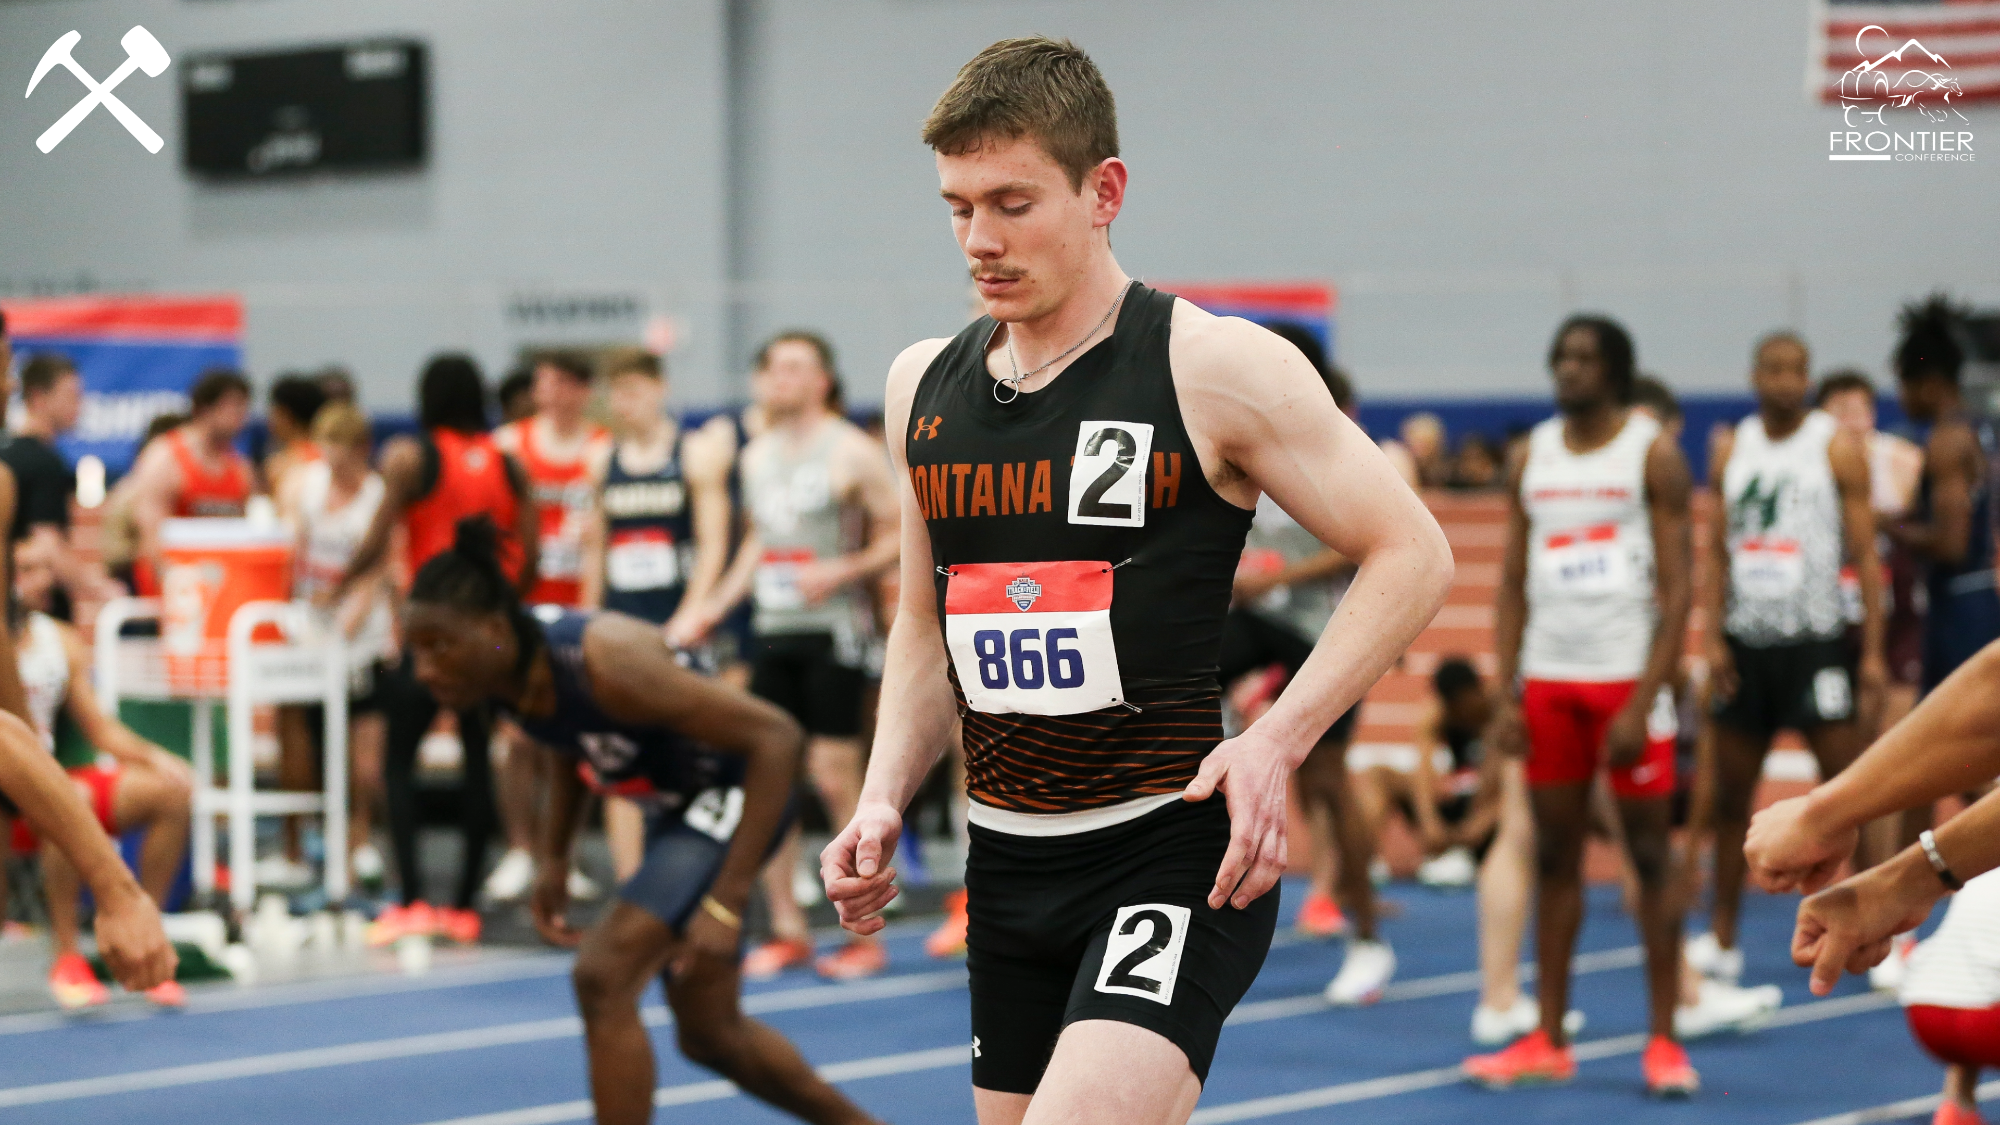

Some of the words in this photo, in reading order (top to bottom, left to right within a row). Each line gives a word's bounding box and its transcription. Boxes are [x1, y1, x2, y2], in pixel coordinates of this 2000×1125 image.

[1077, 427, 1137, 518] 2
[974, 628, 1085, 690] 866
[1105, 908, 1173, 995] 2
